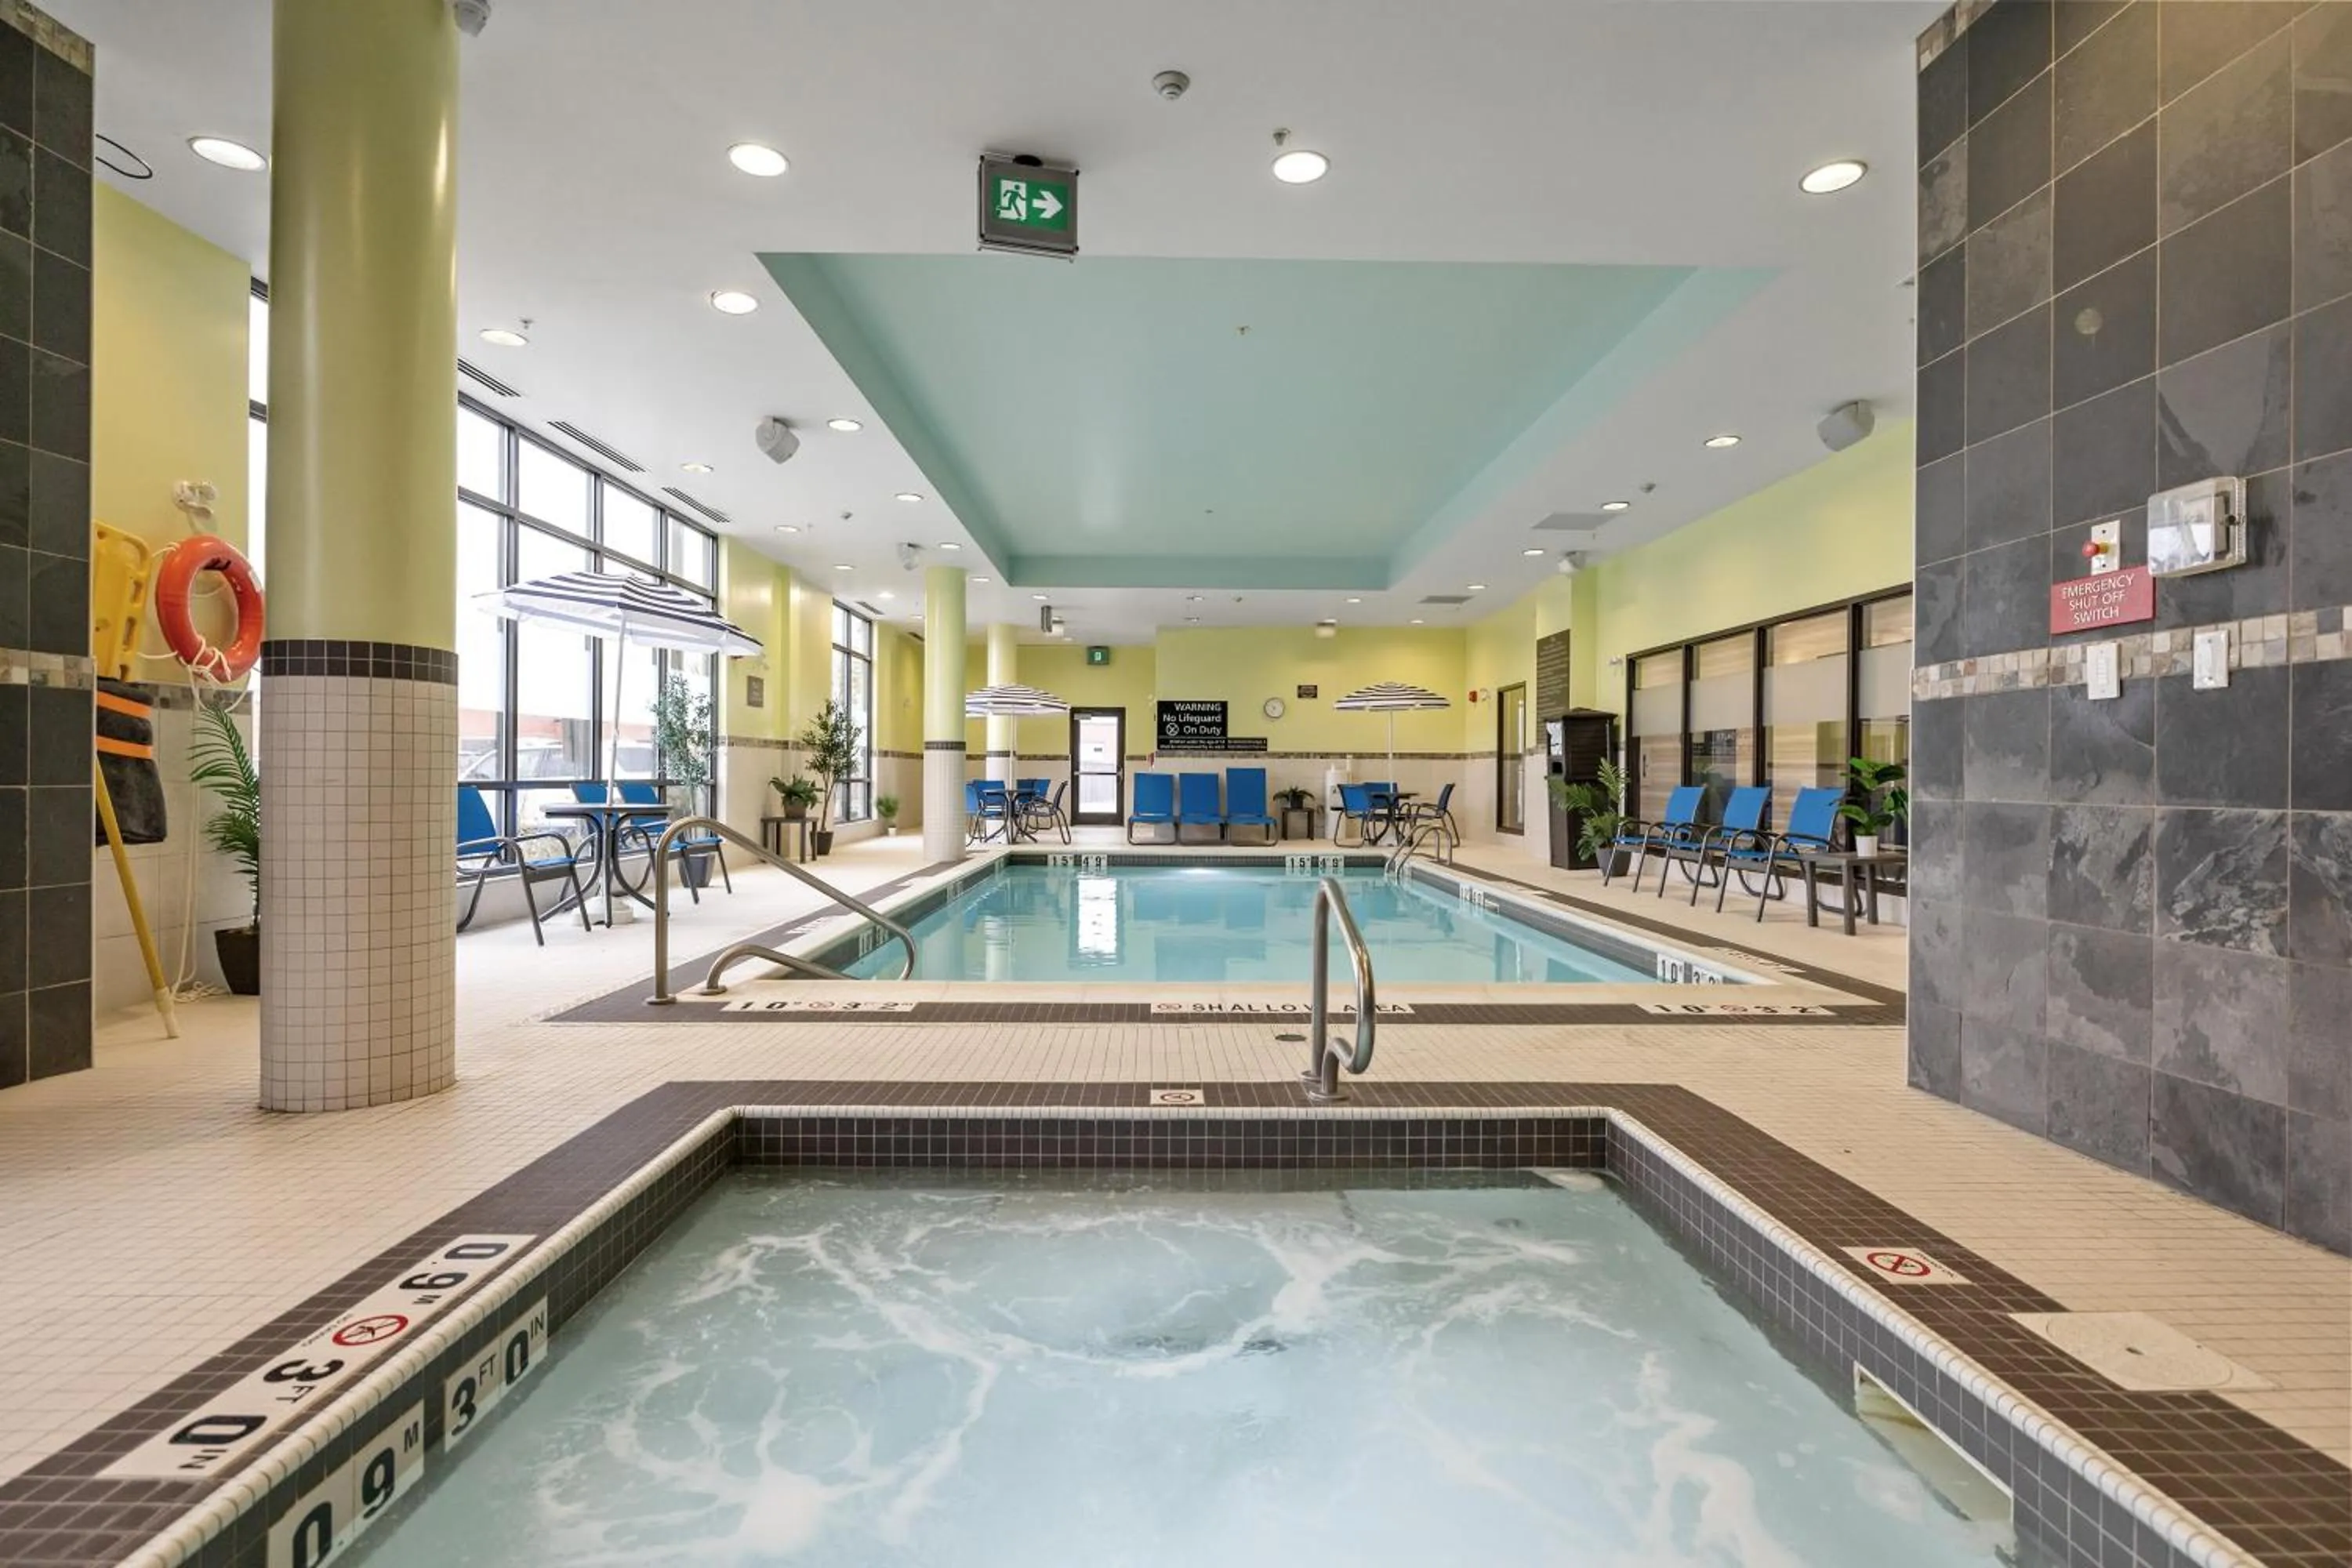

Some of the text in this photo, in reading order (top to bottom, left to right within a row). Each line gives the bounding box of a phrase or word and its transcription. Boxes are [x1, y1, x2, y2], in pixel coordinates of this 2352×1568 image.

[2062, 573, 2135, 600] EMERGENCY
[2069, 590, 2126, 612] SHUT OFF
[2074, 605, 2119, 624] SWITCH
[1174, 702, 1221, 711] WARNING
[1163, 713, 1222, 724] No Lifeguard
[1183, 726, 1222, 736] On Duty
[263, 1359, 343, 1385] 3
[452, 1310, 545, 1437] 3 FT 0 IN
[275, 1385, 316, 1404] FT
[404, 1421, 419, 1454] M
[177, 1448, 227, 1471] IN
